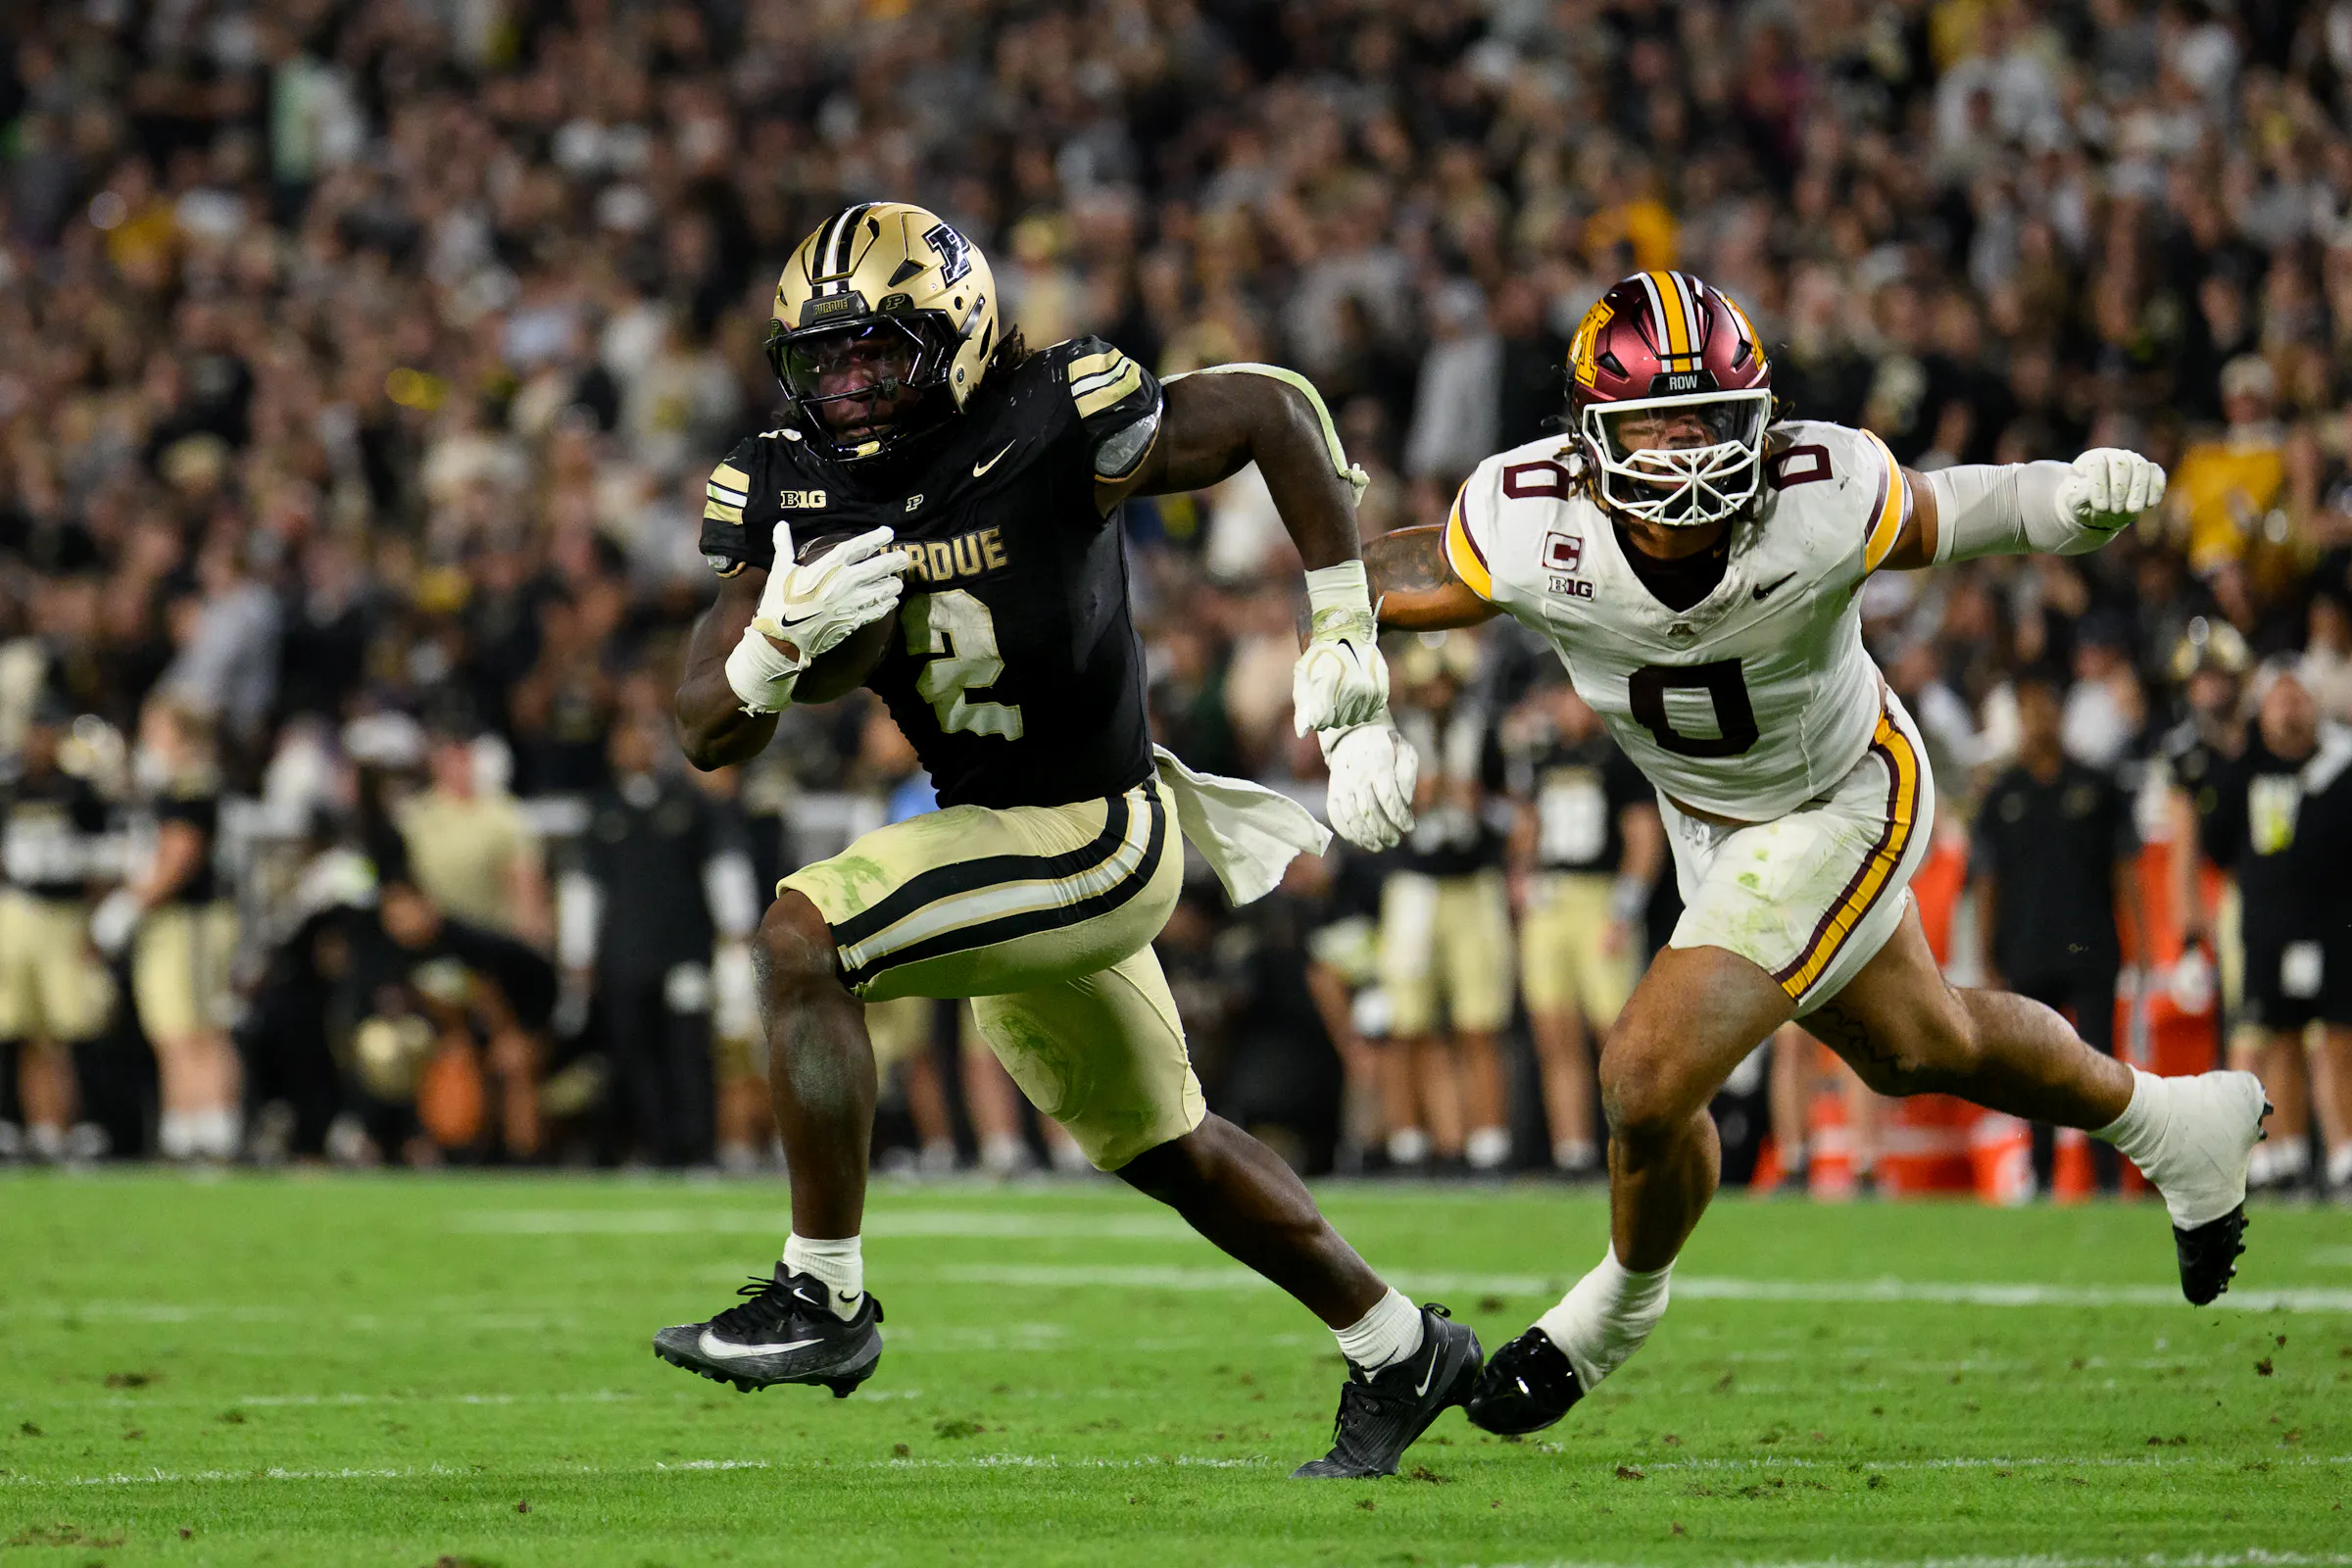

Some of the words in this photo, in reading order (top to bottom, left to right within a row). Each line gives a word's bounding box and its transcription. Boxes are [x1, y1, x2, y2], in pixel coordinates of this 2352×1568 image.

[921, 222, 972, 289] P
[812, 298, 849, 316] PURDUE
[885, 294, 906, 311] P
[1669, 374, 1697, 390] ROW
[1503, 460, 1569, 501] 0
[906, 494, 924, 513] P
[879, 523, 1008, 583] RDUE
[1544, 533, 1580, 570] C
[901, 588, 1023, 742] 2
[1629, 658, 1759, 758] 0
